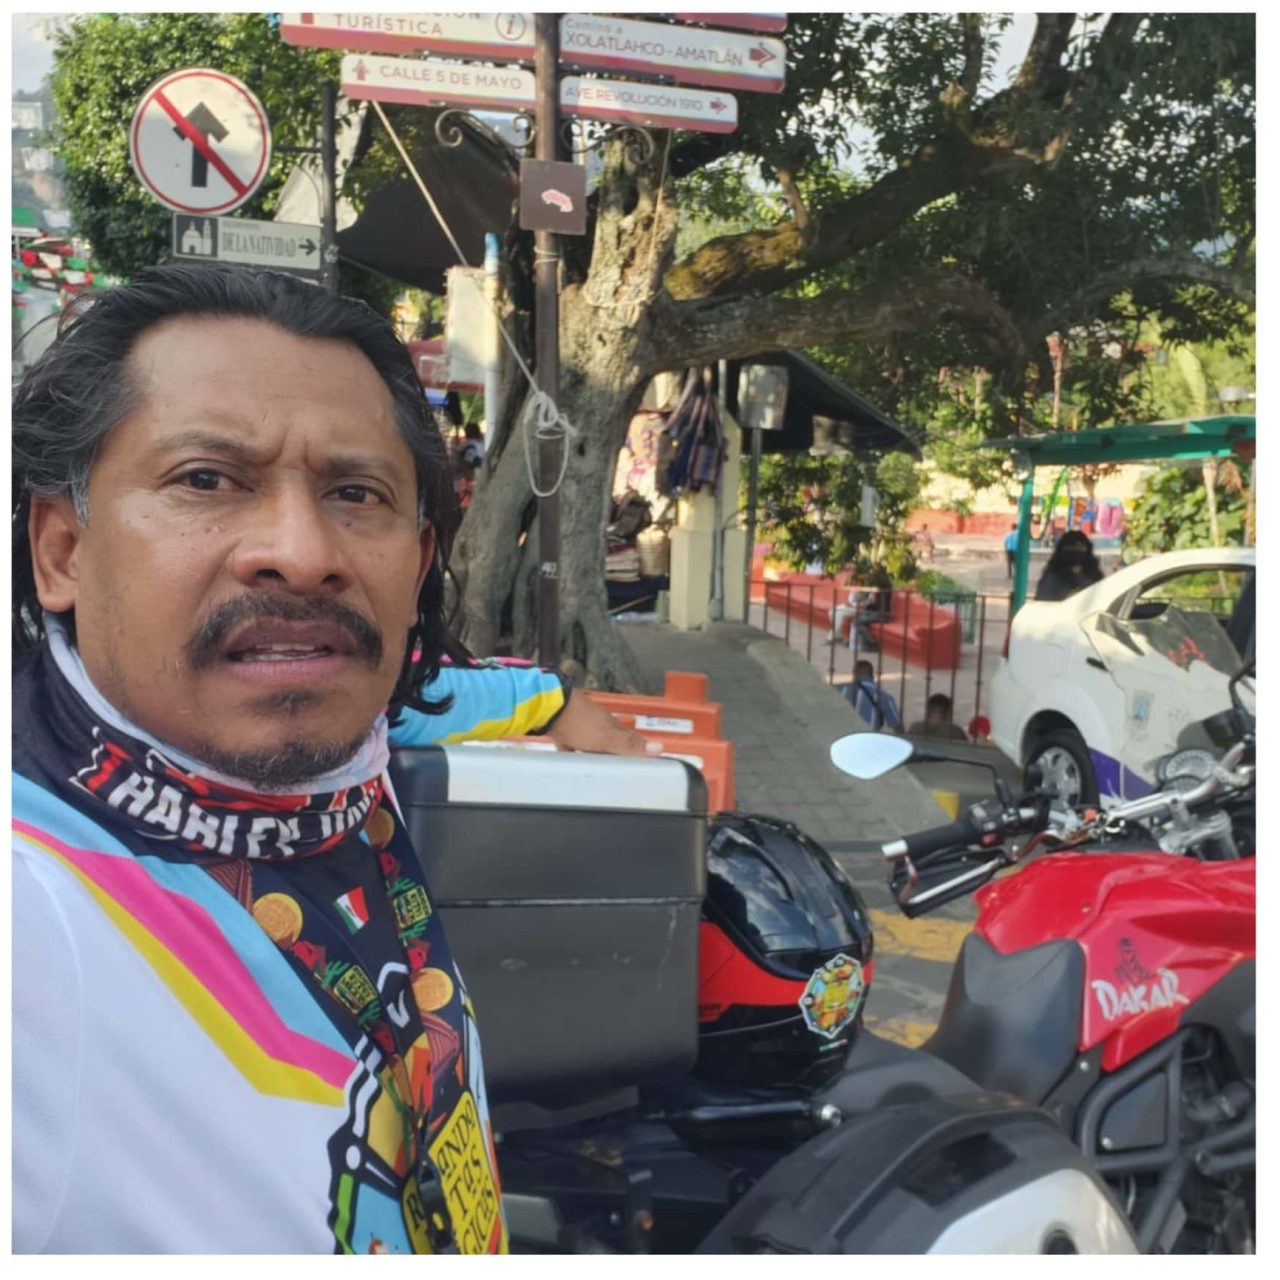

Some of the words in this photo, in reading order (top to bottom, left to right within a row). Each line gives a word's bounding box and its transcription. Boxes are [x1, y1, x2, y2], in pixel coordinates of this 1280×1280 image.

[335, 13, 444, 36] TURÍSTICA
[565, 32, 665, 56] XOLATLAHCO
[675, 45, 744, 66] AMATLÁN
[379, 64, 429, 82] CALLE
[436, 67, 446, 83] 5
[450, 68, 471, 85] DE
[475, 70, 524, 91] MAYO
[595, 88, 677, 109] REVOLUCIÓN
[678, 98, 703, 111] 1910
[1091, 967, 1191, 1022] DAKAR
